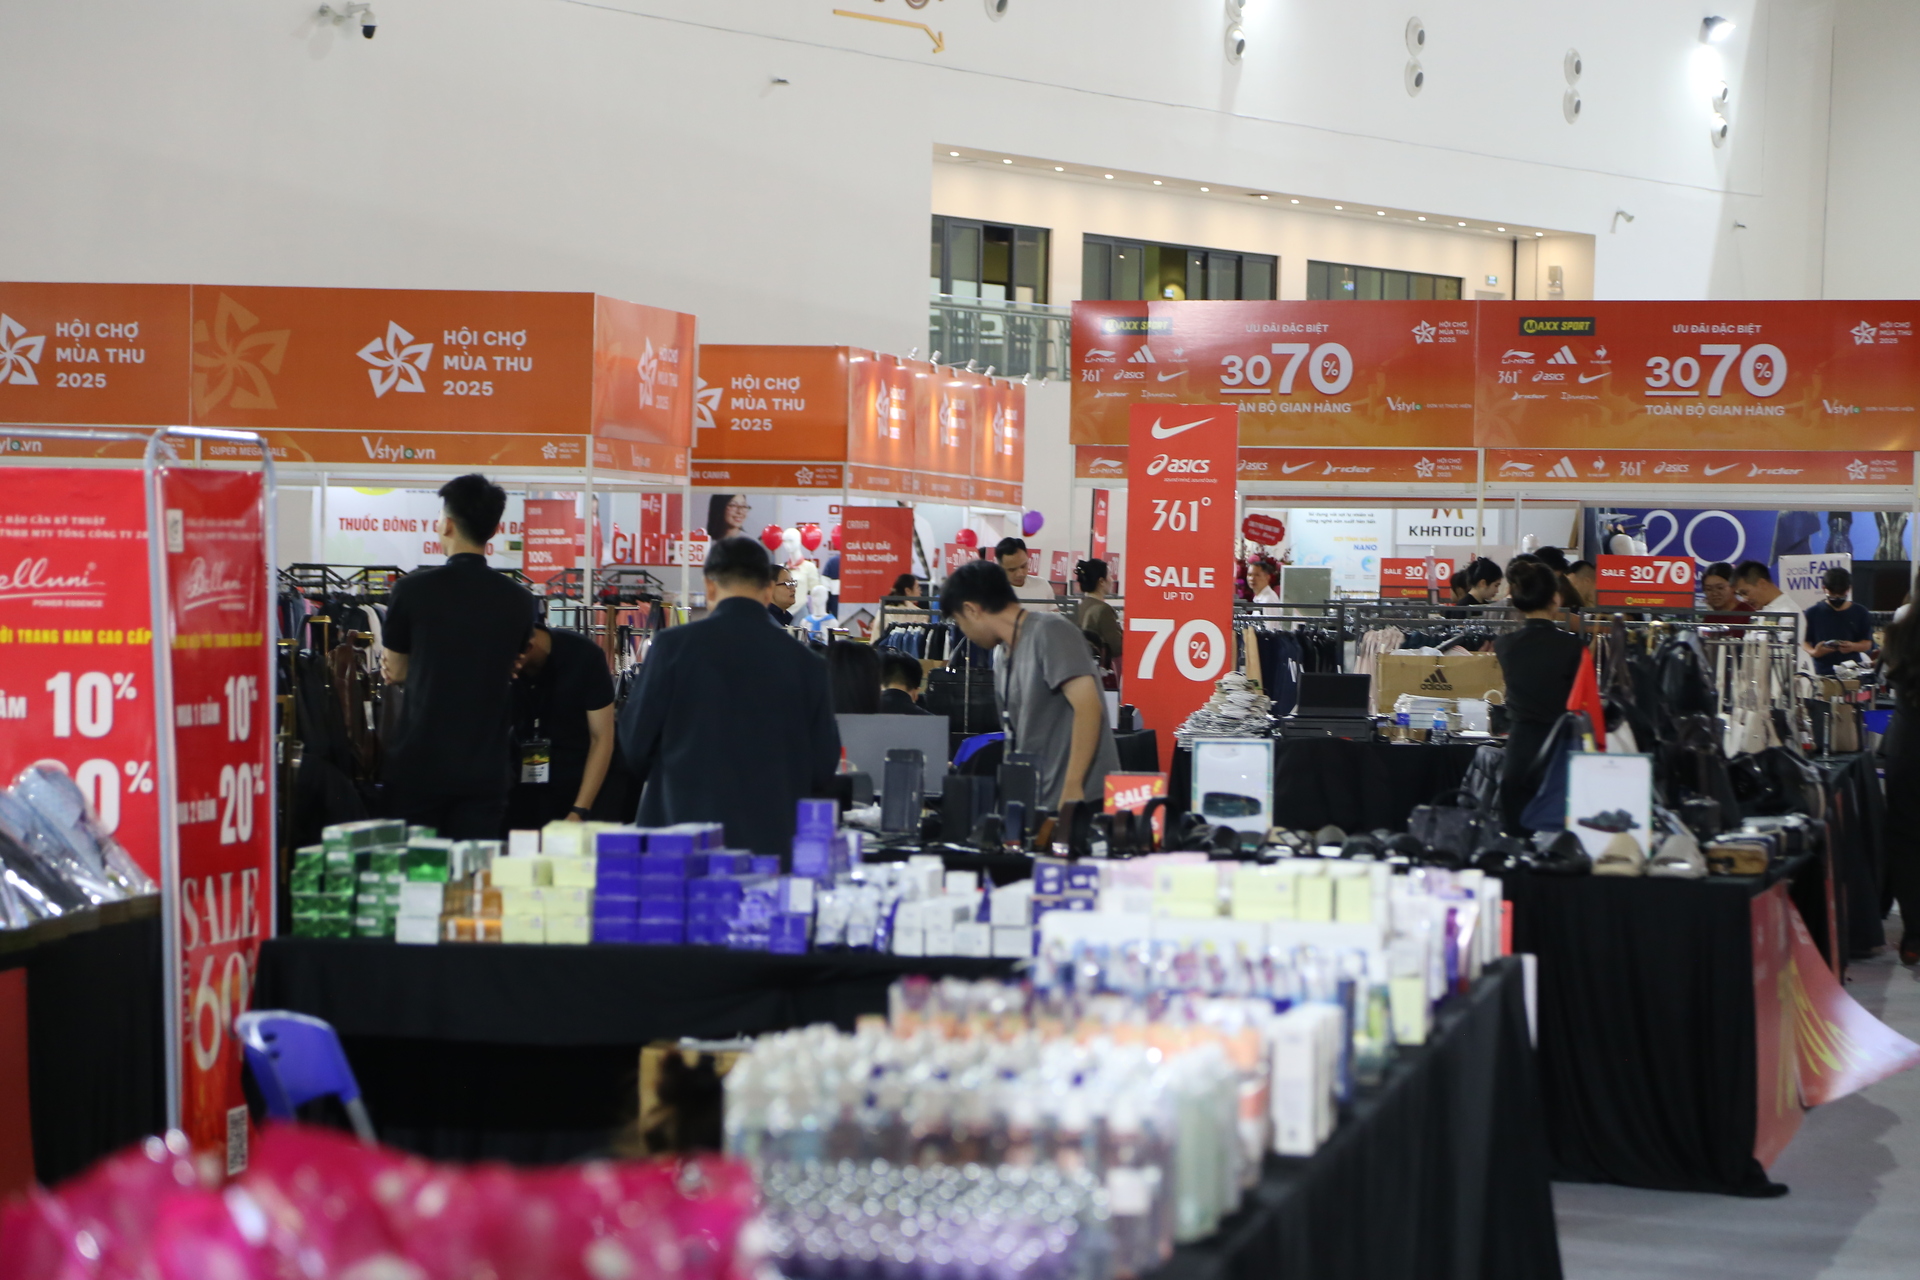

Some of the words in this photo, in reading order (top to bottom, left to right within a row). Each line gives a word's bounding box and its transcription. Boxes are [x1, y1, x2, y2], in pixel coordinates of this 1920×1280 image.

[56, 319, 90, 343] HỘI
[95, 321, 139, 342] CHỢ
[1281, 322, 1304, 335] ĐẶC
[1306, 322, 1329, 335] BIỆT
[1524, 319, 1559, 333] MAXX
[1561, 321, 1591, 331] SPORT
[1690, 322, 1710, 333] ĐÃI
[1711, 322, 1735, 335] ĐẶC
[1737, 322, 1762, 335] BIỆT
[443, 327, 478, 350] HỘI
[483, 329, 527, 350] CHỢ
[56, 344, 100, 363] MÙA
[105, 349, 145, 364] THU
[443, 352, 486, 371] MÙA
[493, 356, 533, 372] THU
[56, 373, 107, 388] 2025
[731, 374, 762, 395] HỘI
[764, 376, 800, 395] CHỢ
[443, 381, 493, 396] 2025
[731, 394, 766, 411] MÙA
[772, 398, 805, 411] THU
[1258, 400, 1277, 415] BỘ
[1280, 403, 1311, 413] GIAN
[1314, 400, 1352, 413] HÀNG
[1645, 402, 1682, 416] TOÀN
[1686, 403, 1705, 418] BỘ
[1708, 405, 1742, 416] GIAN
[1745, 403, 1785, 416] HÀNG
[731, 418, 772, 431] 2025
[210, 446, 237, 455] SUPER
[1757, 467, 1804, 475] rider
[339, 513, 378, 531] THUỐC
[383, 516, 417, 533] ĐÔNG
[422, 520, 429, 532] Y
[1409, 525, 1486, 537] KHATOC
[528, 551, 553, 563] 100%
[679, 553, 704, 562] OU
[867, 553, 898, 564] NGHIỆM
[1144, 566, 1215, 589] SALE
[1601, 569, 1626, 577] SALE
[1163, 591, 1177, 601] UP
[1178, 591, 1194, 601] TO
[18, 629, 59, 644] TRANG
[63, 629, 93, 644] NAM
[97, 629, 123, 644] CAO
[127, 627, 152, 645] CẤP
[1129, 618, 1226, 682] 70%
[46, 672, 137, 738] 10%
[219, 762, 265, 845] 20%
[1114, 784, 1152, 808] SALE
[182, 868, 259, 951] SALE
